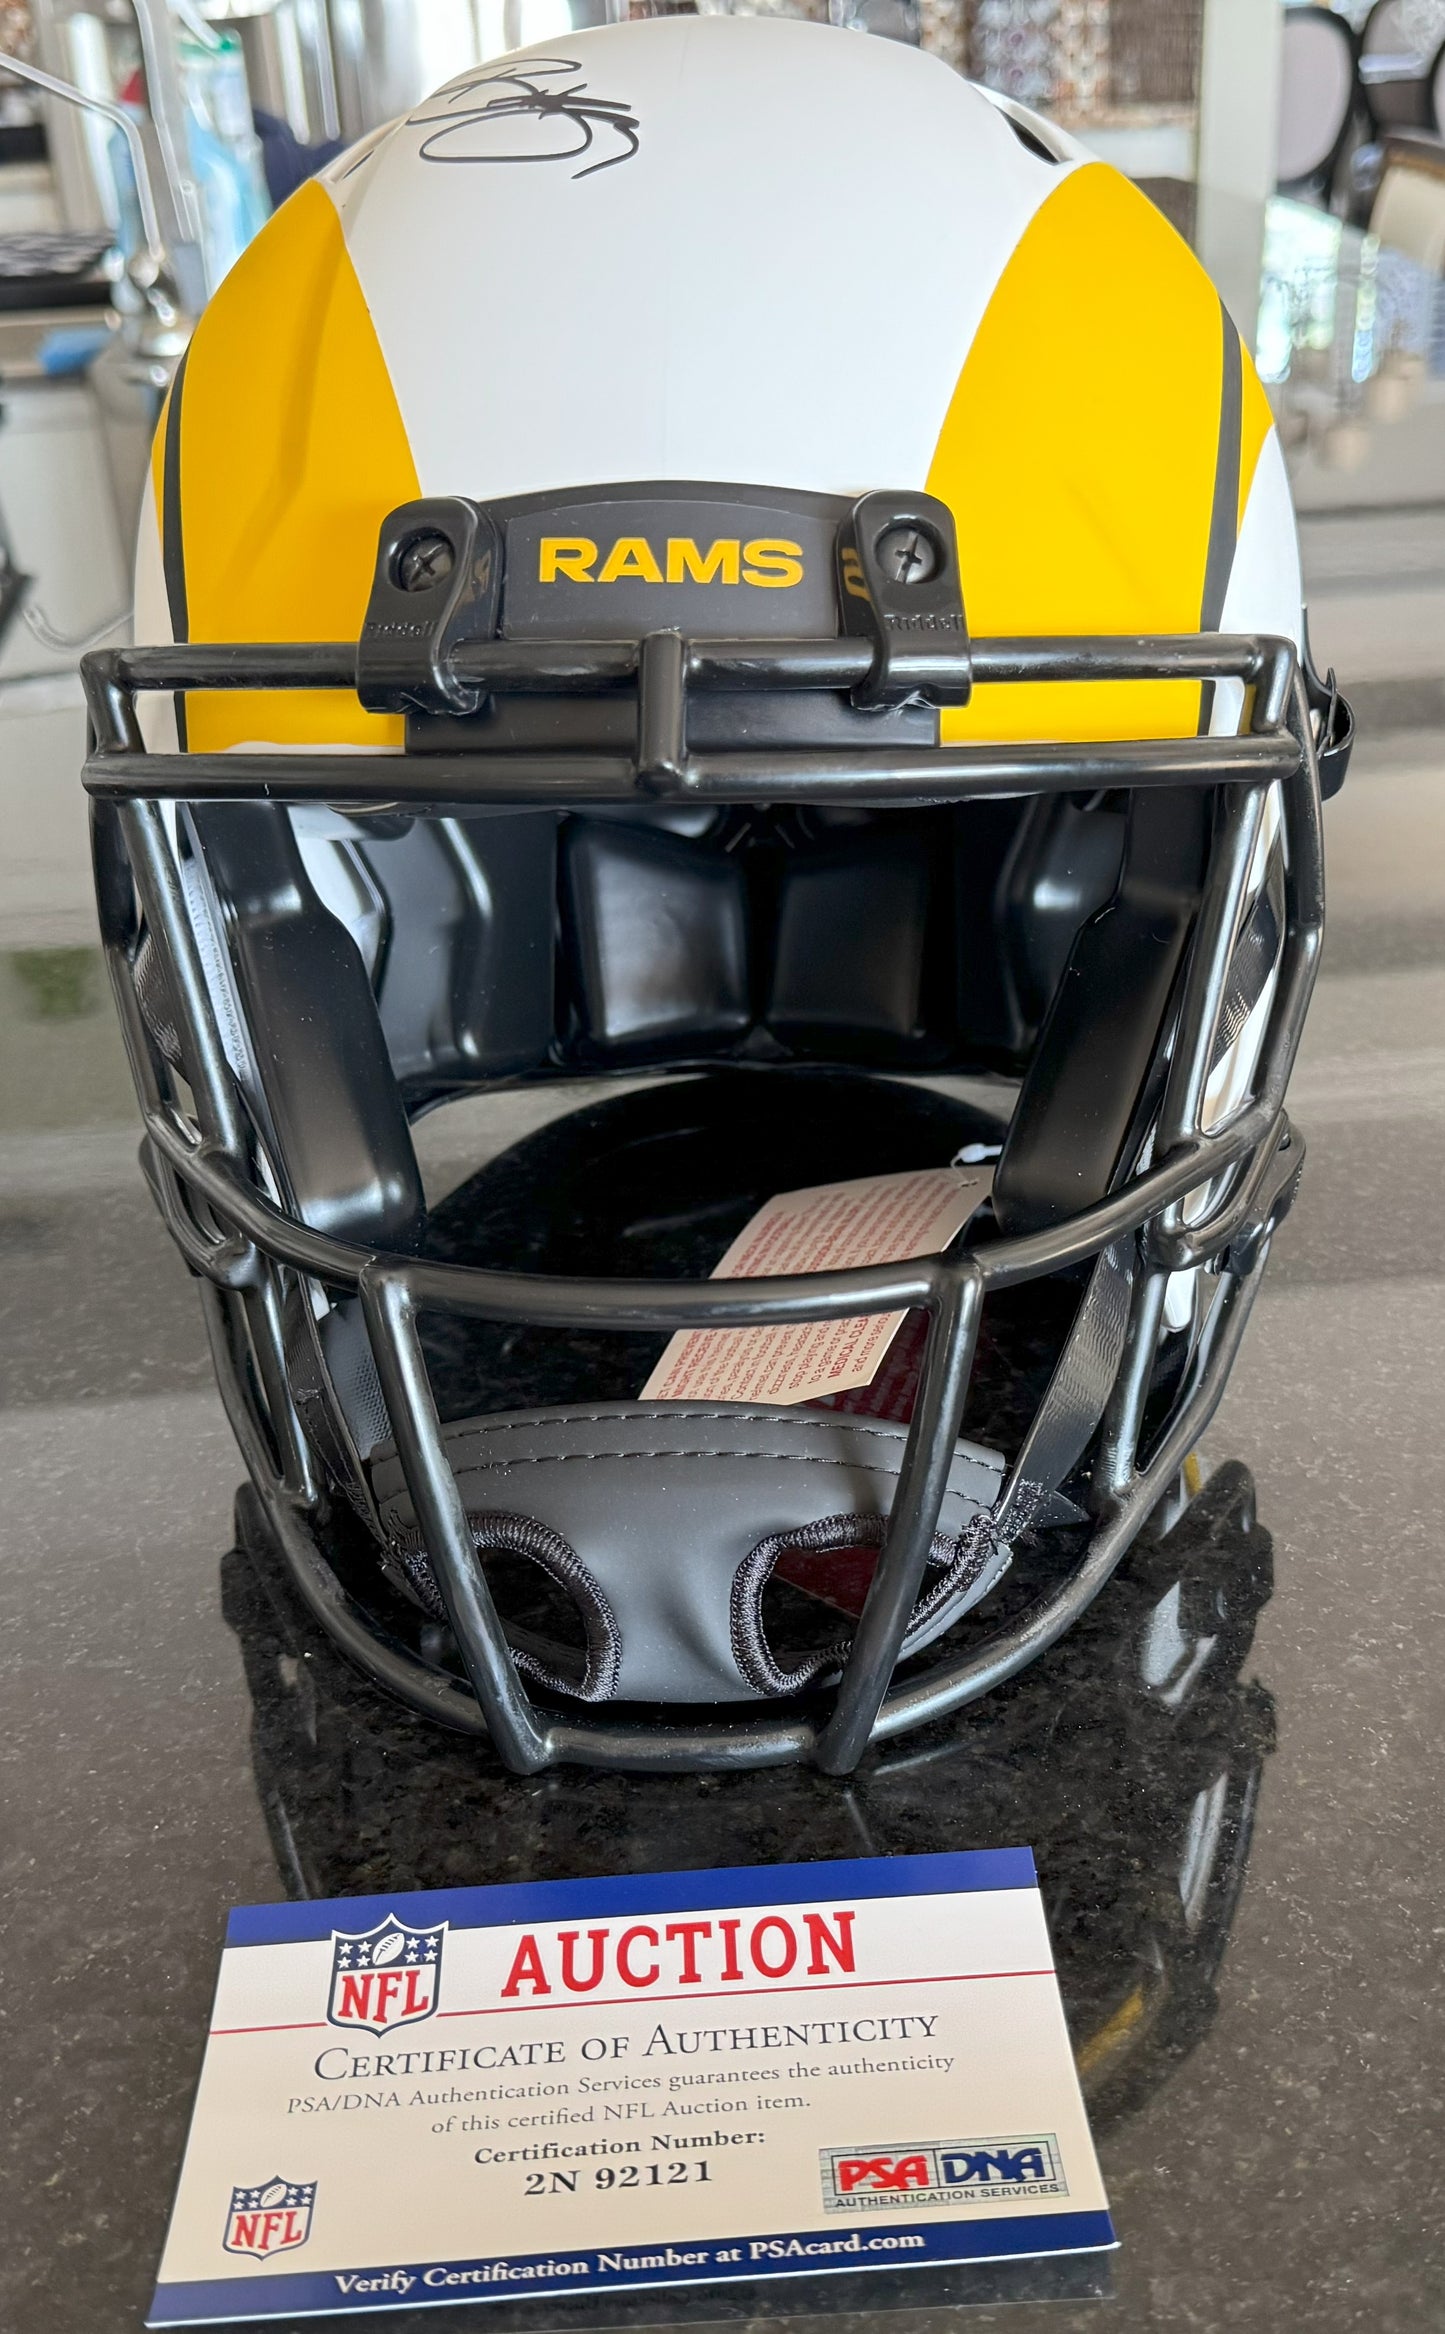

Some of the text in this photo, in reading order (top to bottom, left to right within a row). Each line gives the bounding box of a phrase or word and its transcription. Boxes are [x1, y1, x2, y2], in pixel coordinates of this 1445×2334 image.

[539, 537, 803, 588] RAMS
[500, 1911, 856, 1998] AUCTION
[338, 1969, 429, 2024] NFL
[581, 2037, 630, 2061] OF
[287, 2055, 955, 2114] PSA/DNA Authentication Services guarantees the authenticity
[431, 2094, 811, 2134] of this certified NFL Auction item.
[473, 2129, 766, 2165] Certification Number:
[523, 2159, 713, 2197] 2N 92121
[838, 2147, 1046, 2192] PSA DNA
[834, 2183, 1060, 2209] AUTHENTICATION SERVICES
[230, 2210, 303, 2251] NFL
[334, 2233, 926, 2295] Verify Certification Number at PSAcard.com
